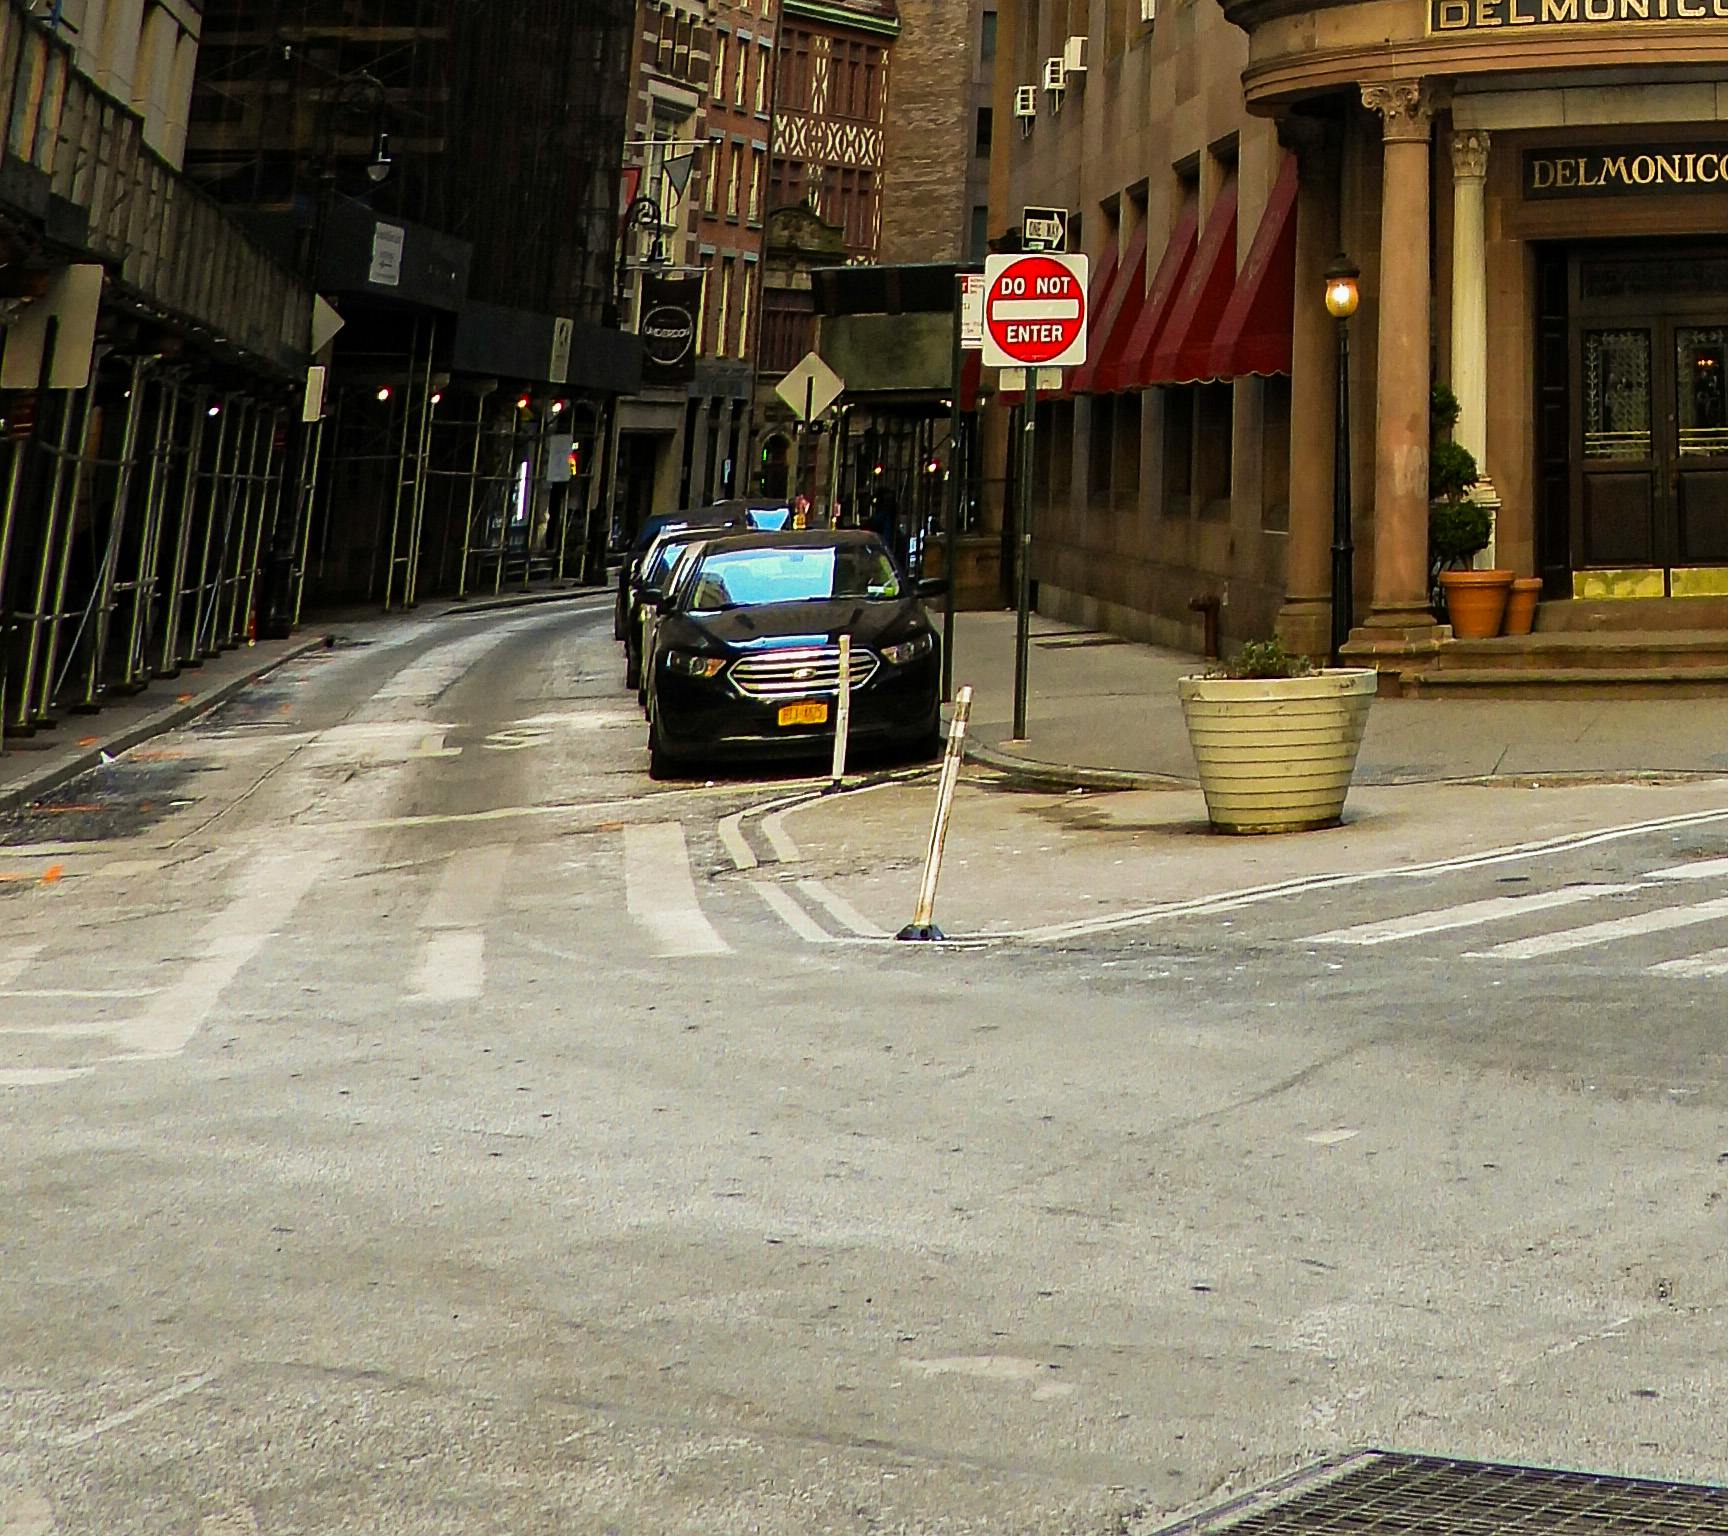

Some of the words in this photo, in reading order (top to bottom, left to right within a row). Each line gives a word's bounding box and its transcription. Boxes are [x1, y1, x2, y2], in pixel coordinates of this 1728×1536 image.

[1001, 277, 1026, 295] DO
[1036, 276, 1071, 294] NOT
[1006, 325, 1063, 343] ENTER
